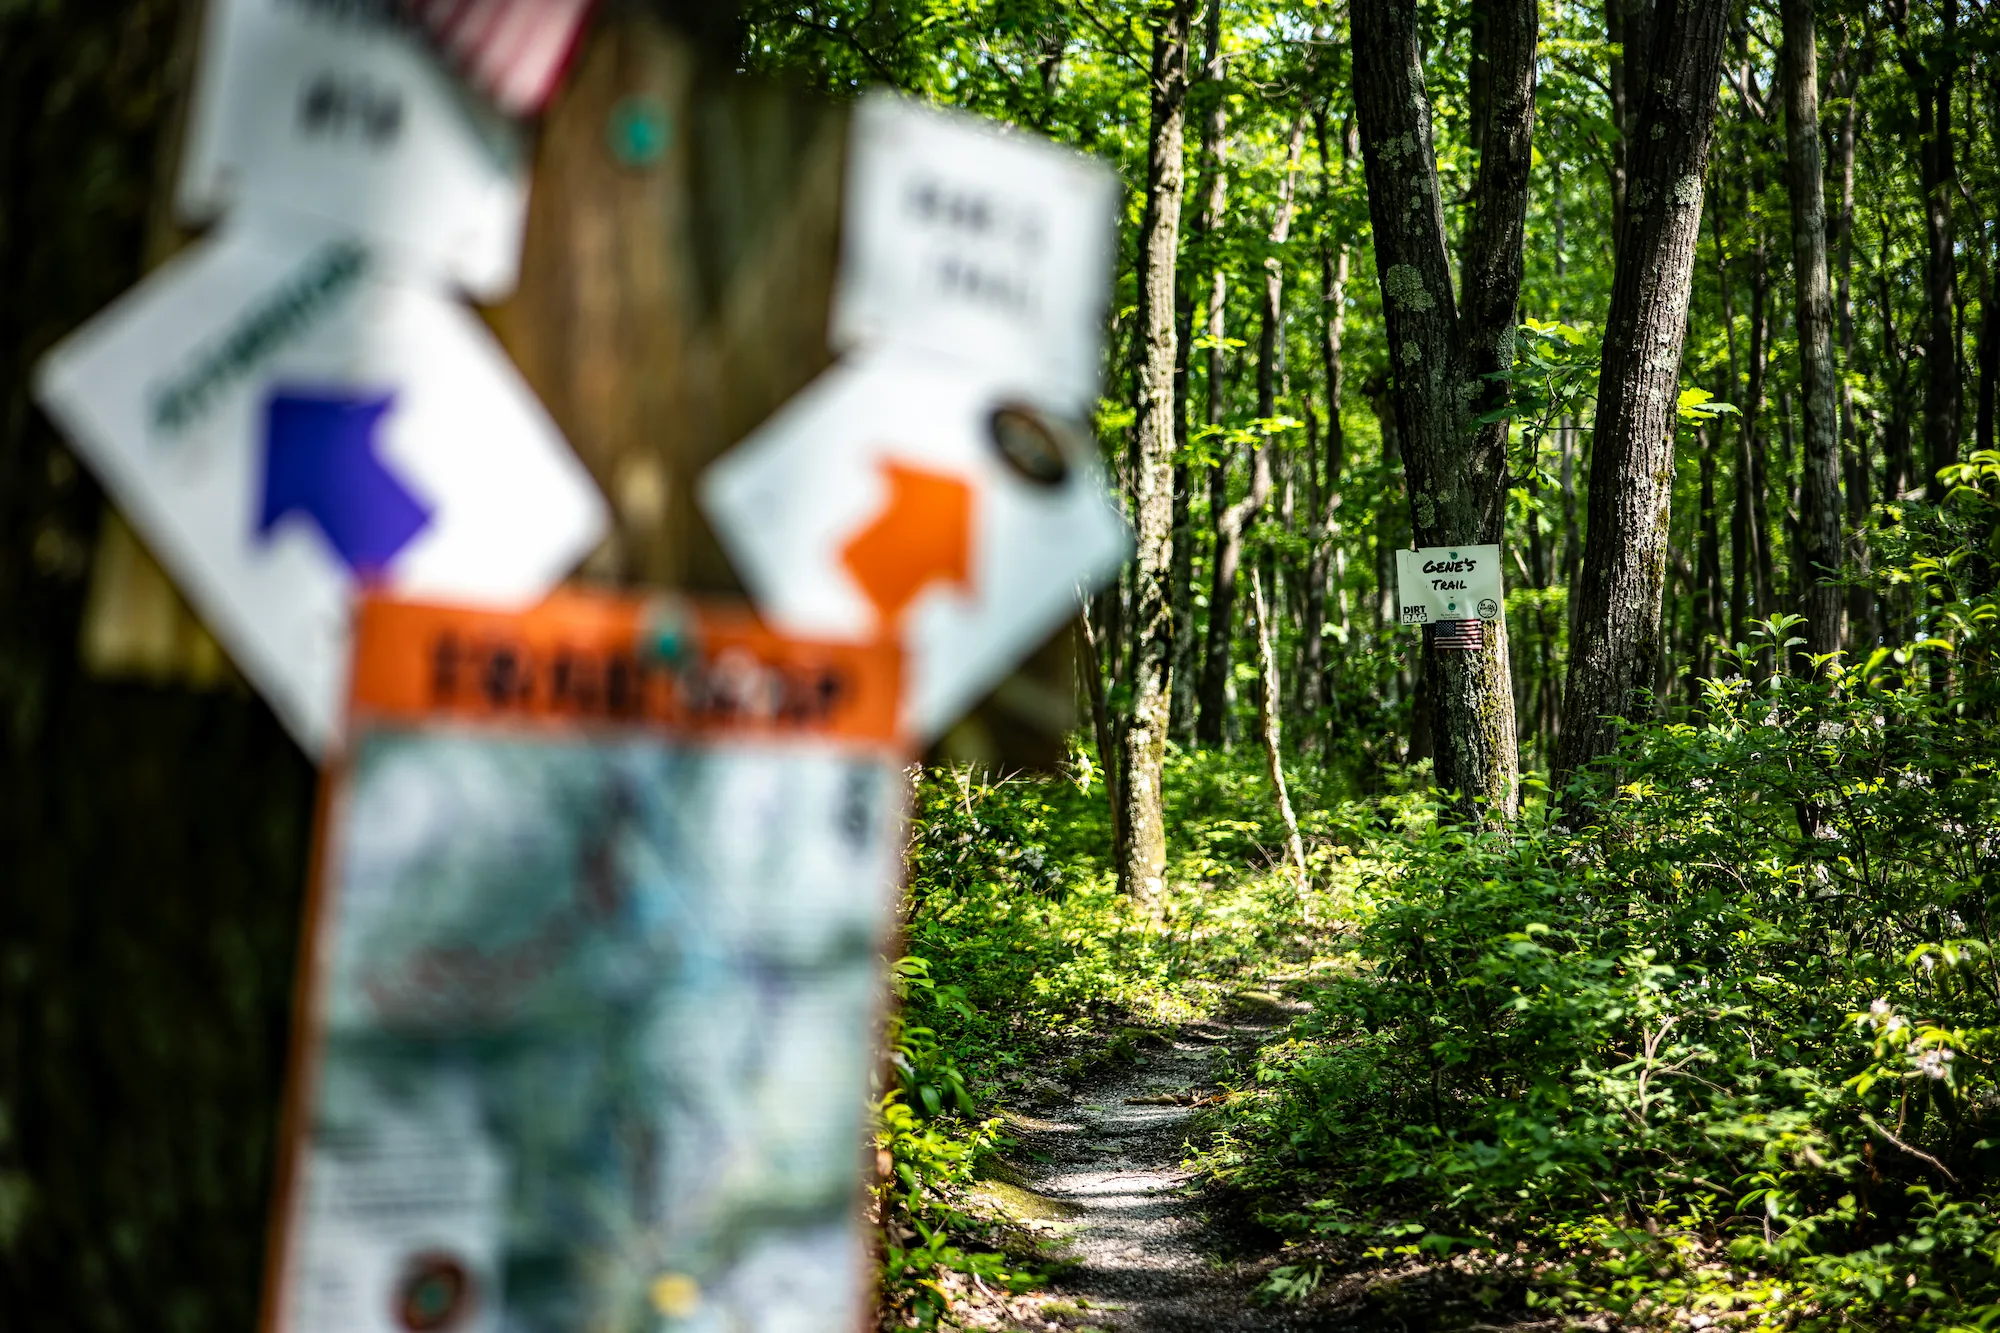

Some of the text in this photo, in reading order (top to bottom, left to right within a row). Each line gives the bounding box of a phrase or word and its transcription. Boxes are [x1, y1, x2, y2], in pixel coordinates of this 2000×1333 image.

[1422, 558, 1476, 573] GENE'S
[1431, 580, 1467, 590] TRAIL
[1403, 605, 1425, 614] DIRT
[1403, 614, 1427, 623] RAG
